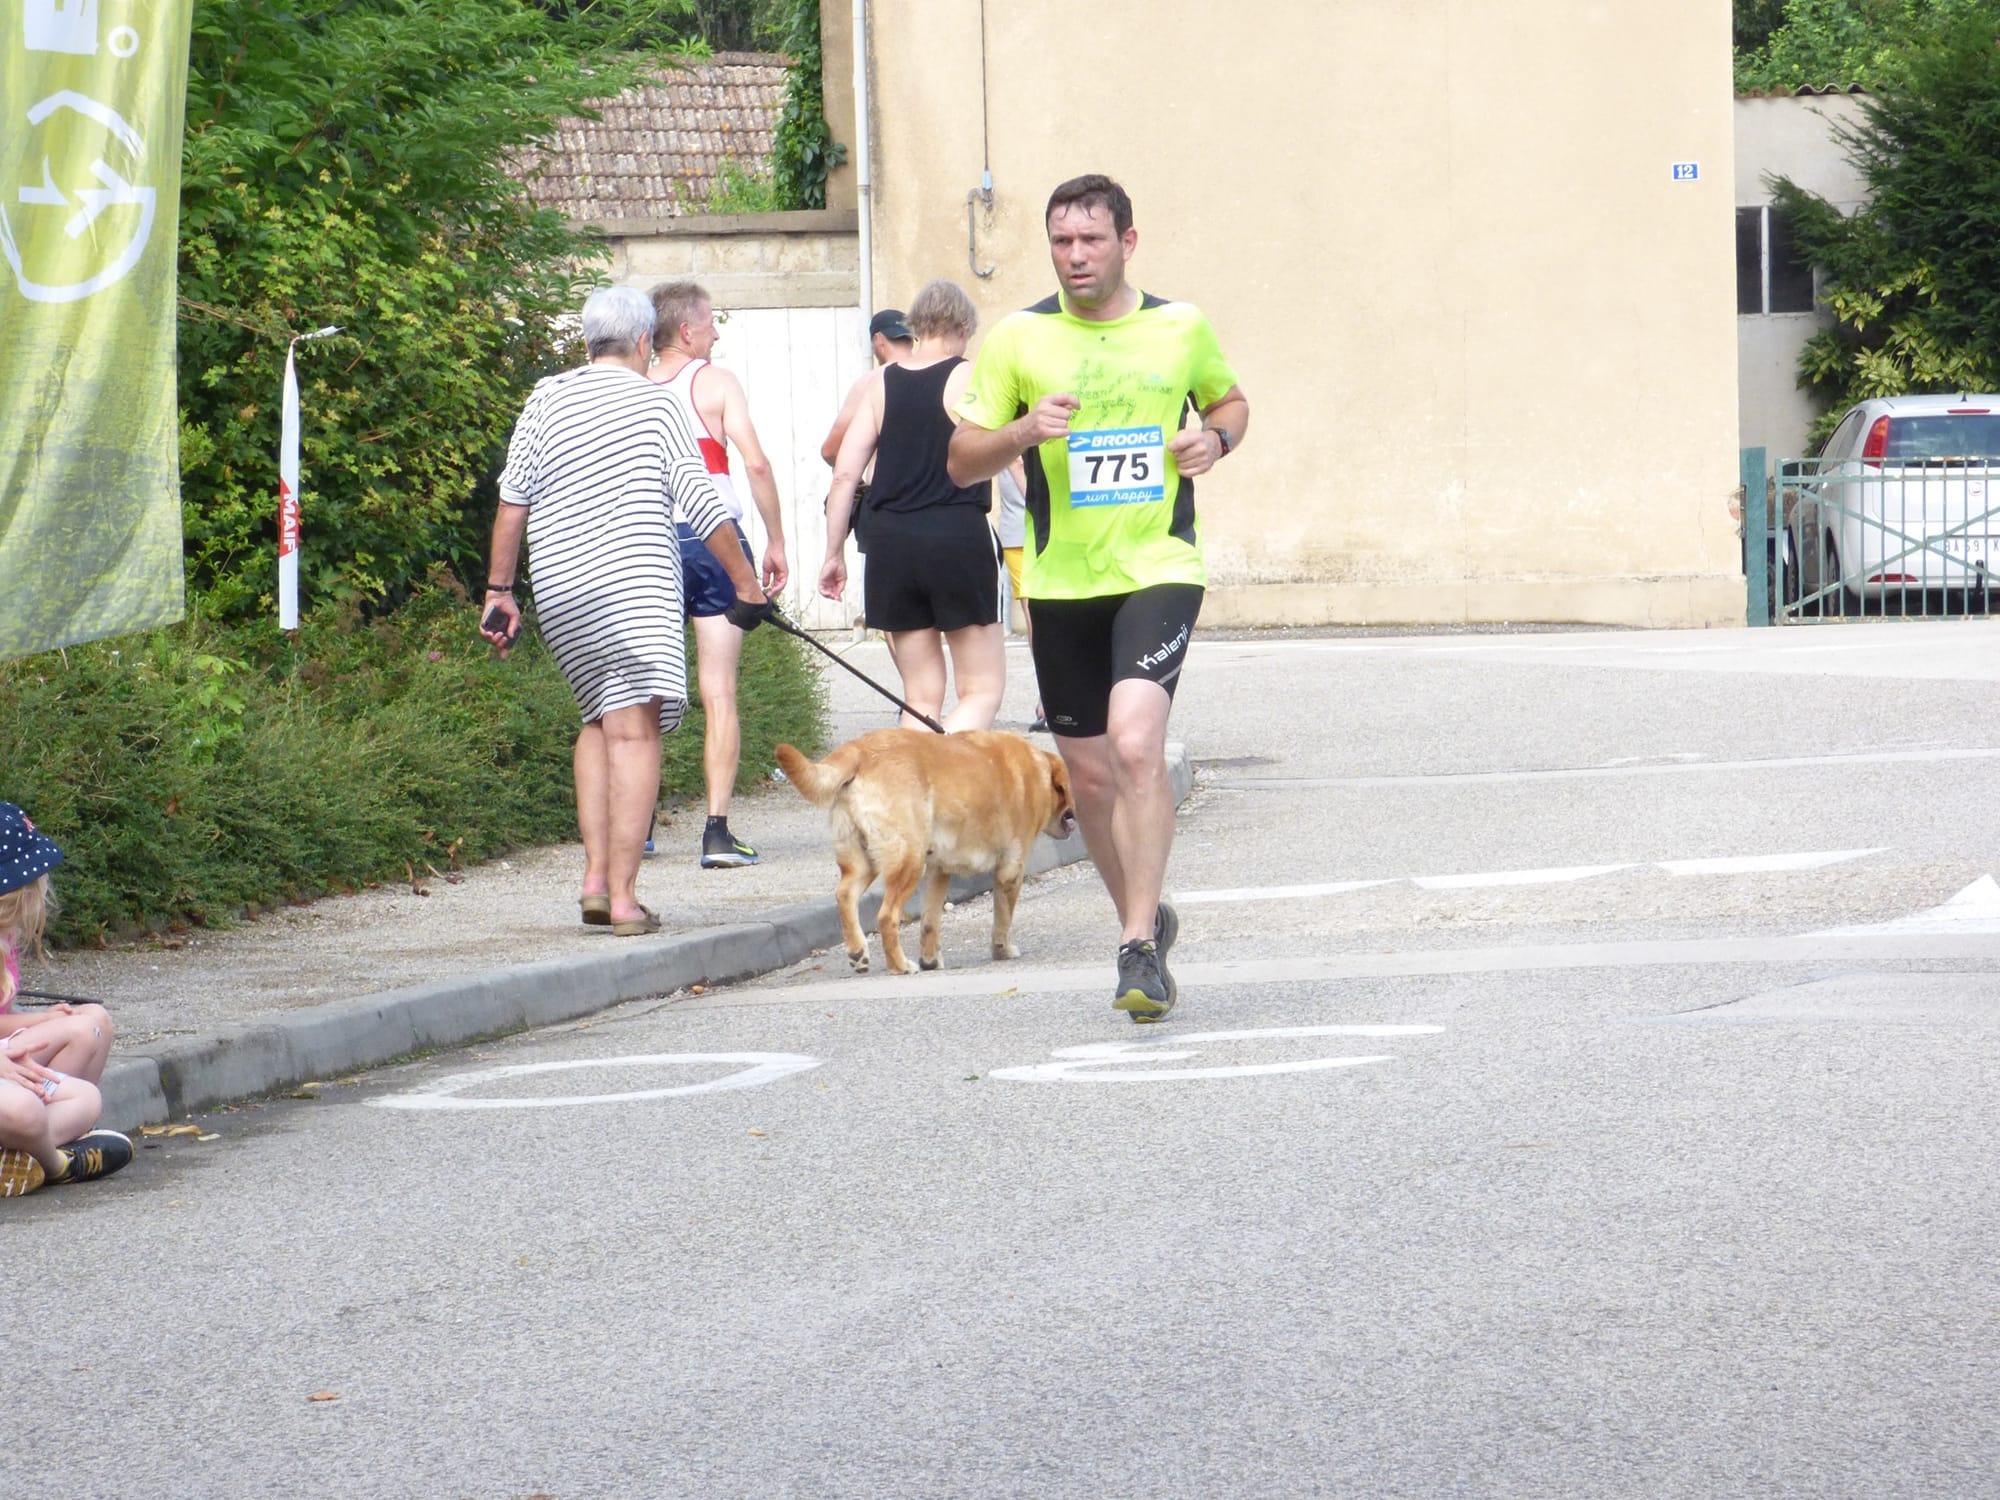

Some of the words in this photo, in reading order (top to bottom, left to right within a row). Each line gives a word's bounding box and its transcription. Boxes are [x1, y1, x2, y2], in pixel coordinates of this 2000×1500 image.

[1676, 164, 1694, 178] 12
[1091, 430, 1161, 449] BROOKS
[1085, 452, 1150, 485] 775
[1084, 492, 1109, 503] run
[1111, 489, 1153, 505] happy
[283, 492, 297, 552] MAIF
[1136, 623, 1190, 671] Kalenji
